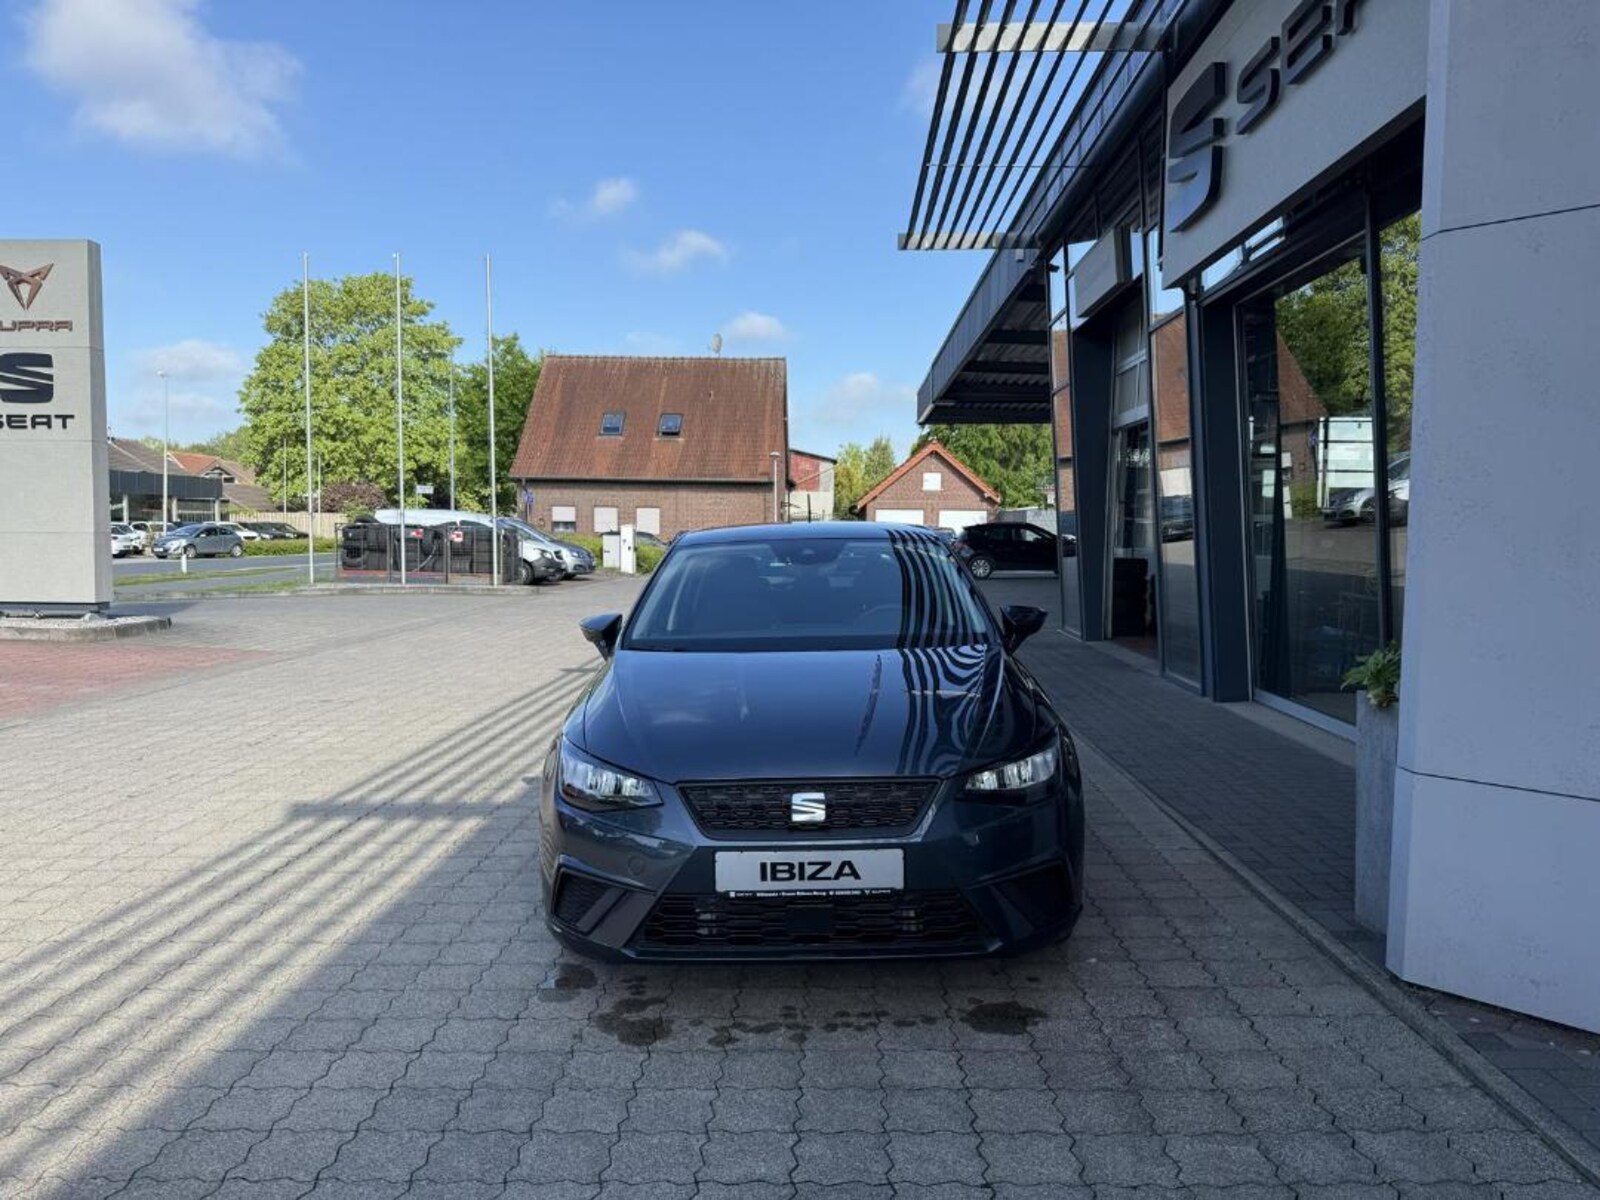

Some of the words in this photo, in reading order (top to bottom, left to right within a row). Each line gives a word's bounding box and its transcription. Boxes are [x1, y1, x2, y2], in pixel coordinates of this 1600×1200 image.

[1236, 0, 1359, 135] SE
[0, 320, 73, 332] UPRA
[0, 414, 75, 430] EAT
[759, 860, 862, 882] IBIZA
